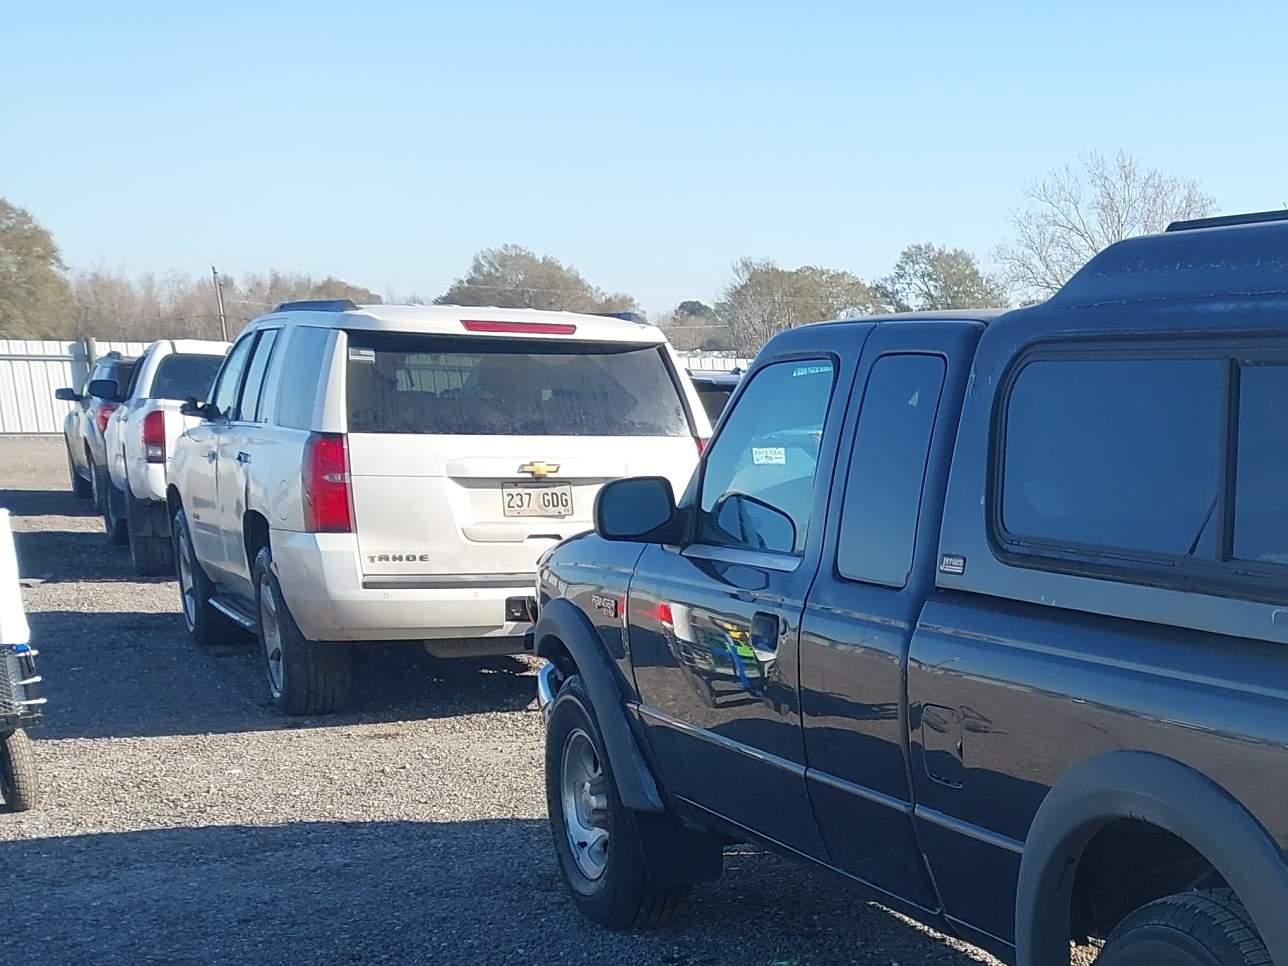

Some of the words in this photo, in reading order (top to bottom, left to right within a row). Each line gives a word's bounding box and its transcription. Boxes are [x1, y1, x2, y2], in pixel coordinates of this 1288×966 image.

[506, 493, 532, 509] 237
[542, 492, 569, 508] GDG
[367, 553, 430, 564] TAHOE
